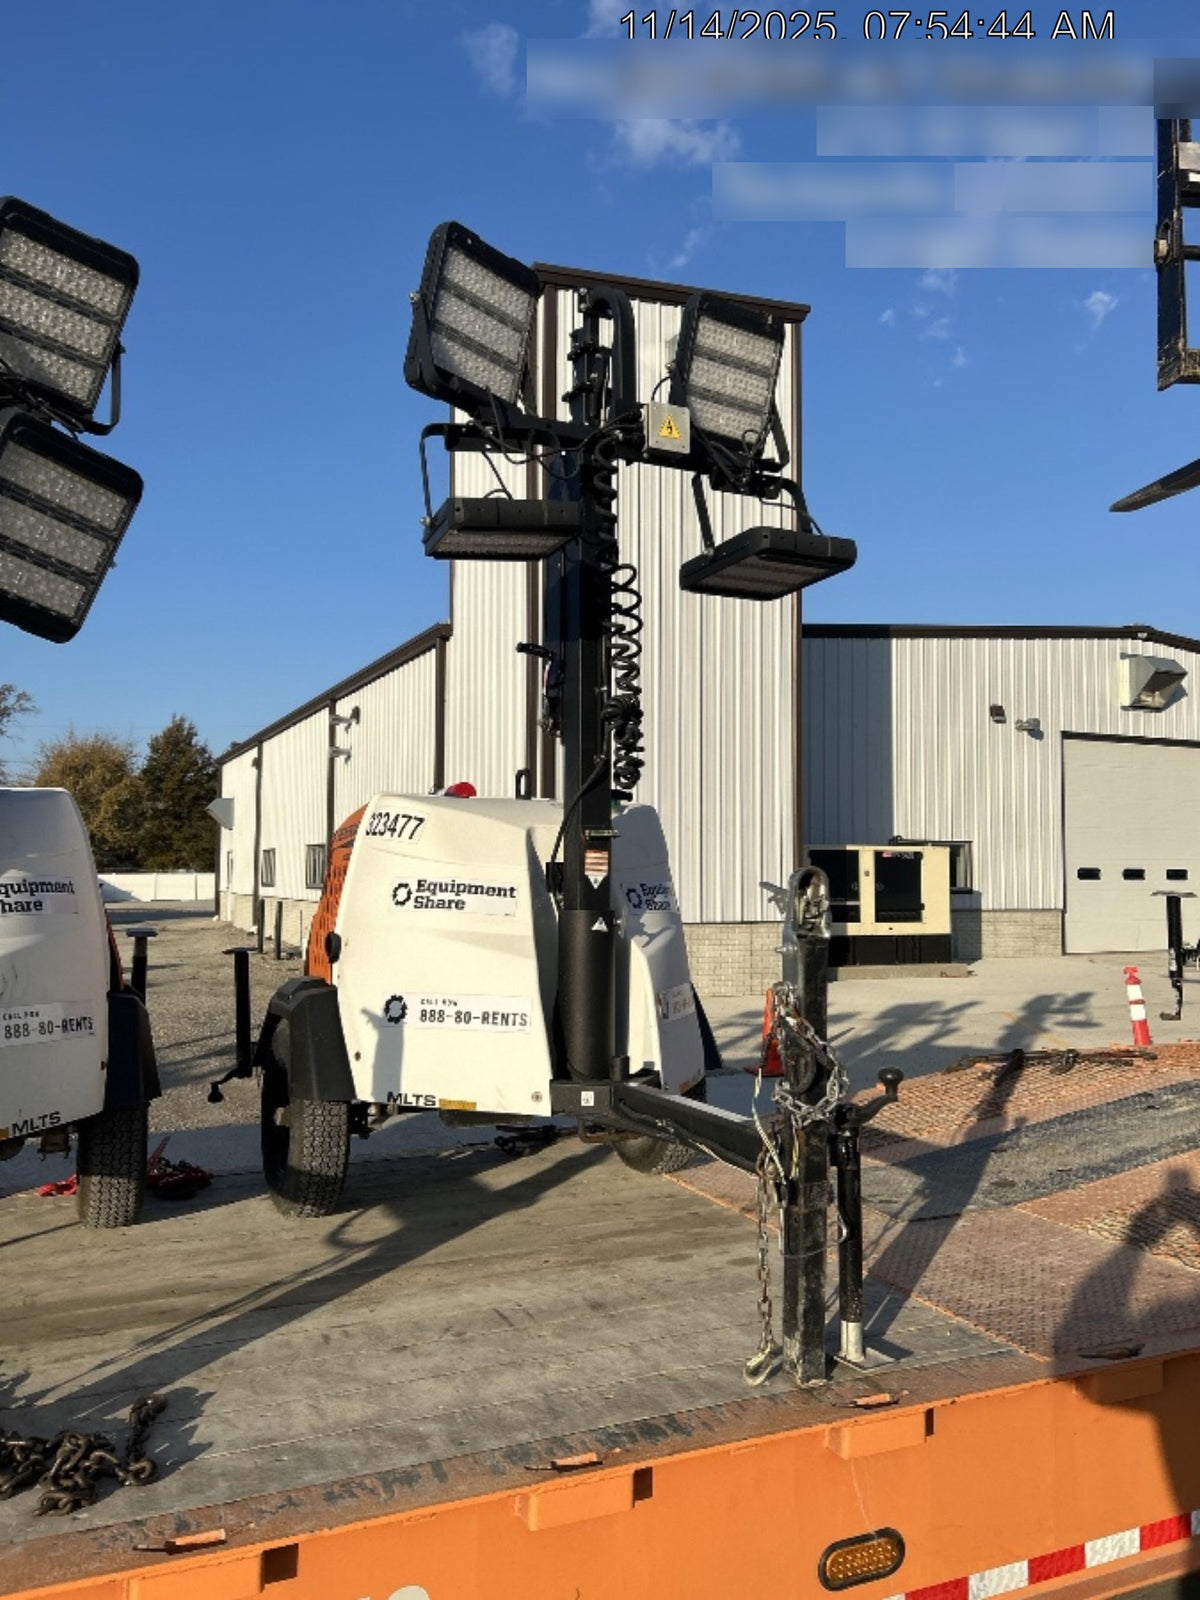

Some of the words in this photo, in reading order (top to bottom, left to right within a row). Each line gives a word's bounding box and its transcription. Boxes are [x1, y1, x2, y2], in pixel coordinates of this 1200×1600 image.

[366, 812, 425, 840] 323477
[0, 879, 75, 898] quipment
[415, 879, 517, 899] Equipment
[0, 899, 43, 914] hare
[413, 896, 466, 911] Share
[420, 1009, 528, 1027] 888-80-RENTS
[4, 1016, 94, 1040] 888-80-RENTS
[387, 1091, 437, 1107] MLTS
[11, 1111, 61, 1136] MLTS
